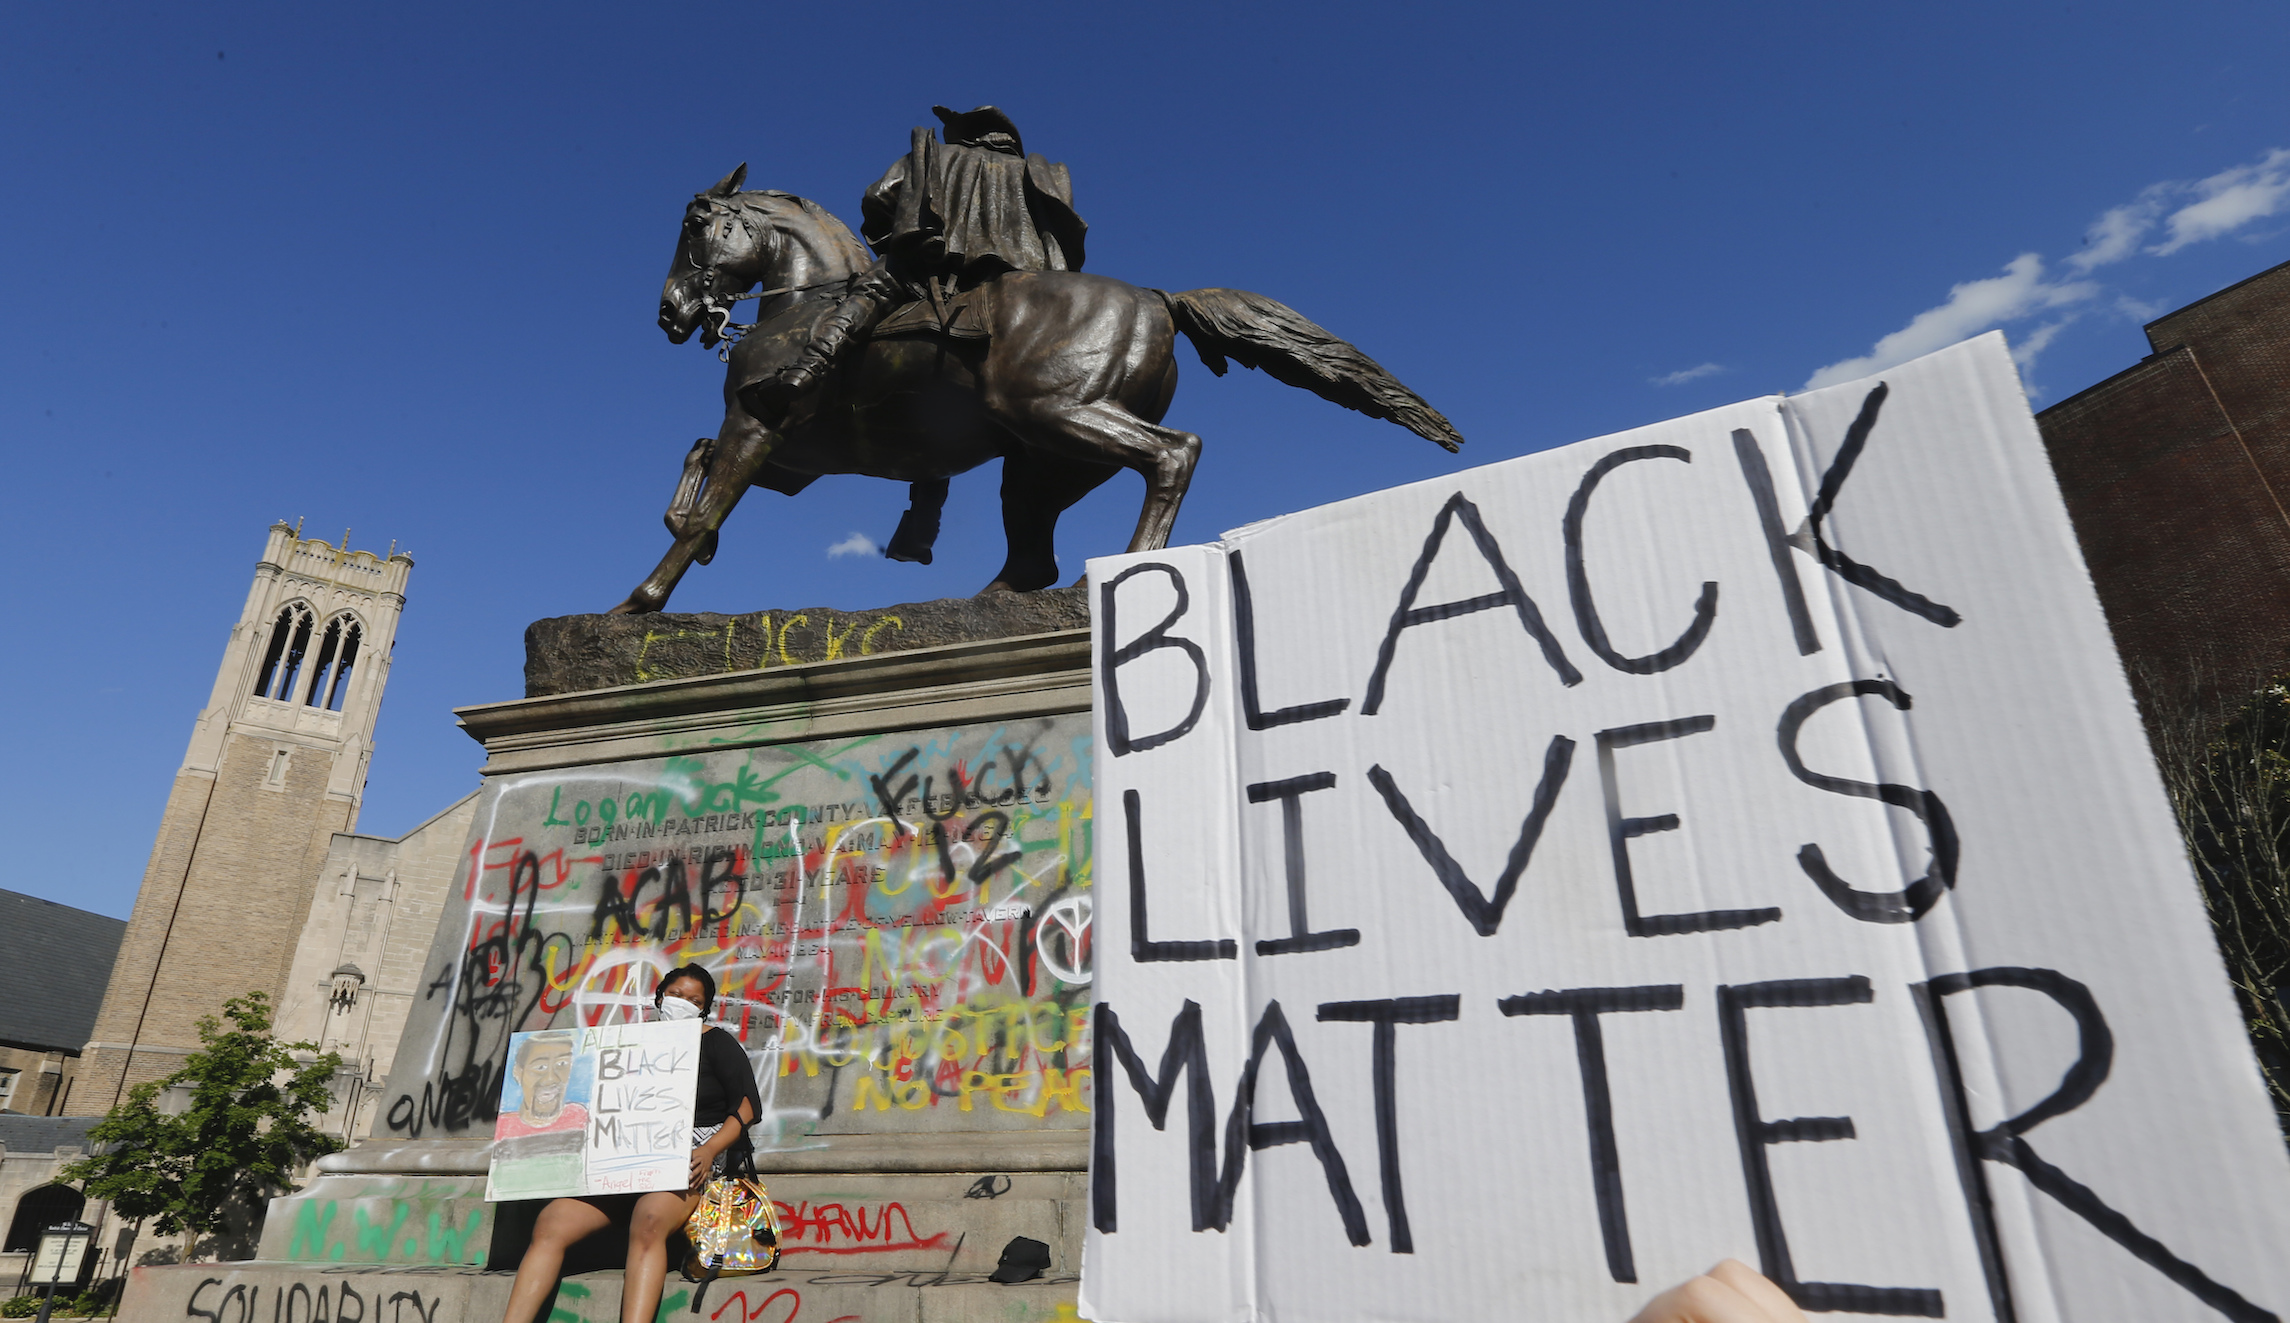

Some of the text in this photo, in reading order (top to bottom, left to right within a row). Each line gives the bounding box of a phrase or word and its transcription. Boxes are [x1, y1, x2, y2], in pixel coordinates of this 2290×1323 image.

[1100, 380, 1962, 757] BLACK
[870, 718, 1052, 837] FUCK
[573, 823, 630, 845] BORN
[635, 821, 656, 839] IN
[663, 810, 758, 838] PATRICK
[1122, 677, 1960, 963] LIVES
[602, 851, 651, 872] DIED
[931, 810, 1023, 887] 12
[590, 850, 745, 942] ACAB
[804, 865, 886, 888] YEARS
[581, 1024, 638, 1054] ALL
[598, 1047, 690, 1080] BLACK
[596, 1083, 684, 1113] LIVES
[852, 1068, 1091, 1118] NO PEAC
[593, 1114, 688, 1154] MATTER
[1092, 965, 2284, 1323] MATTER
